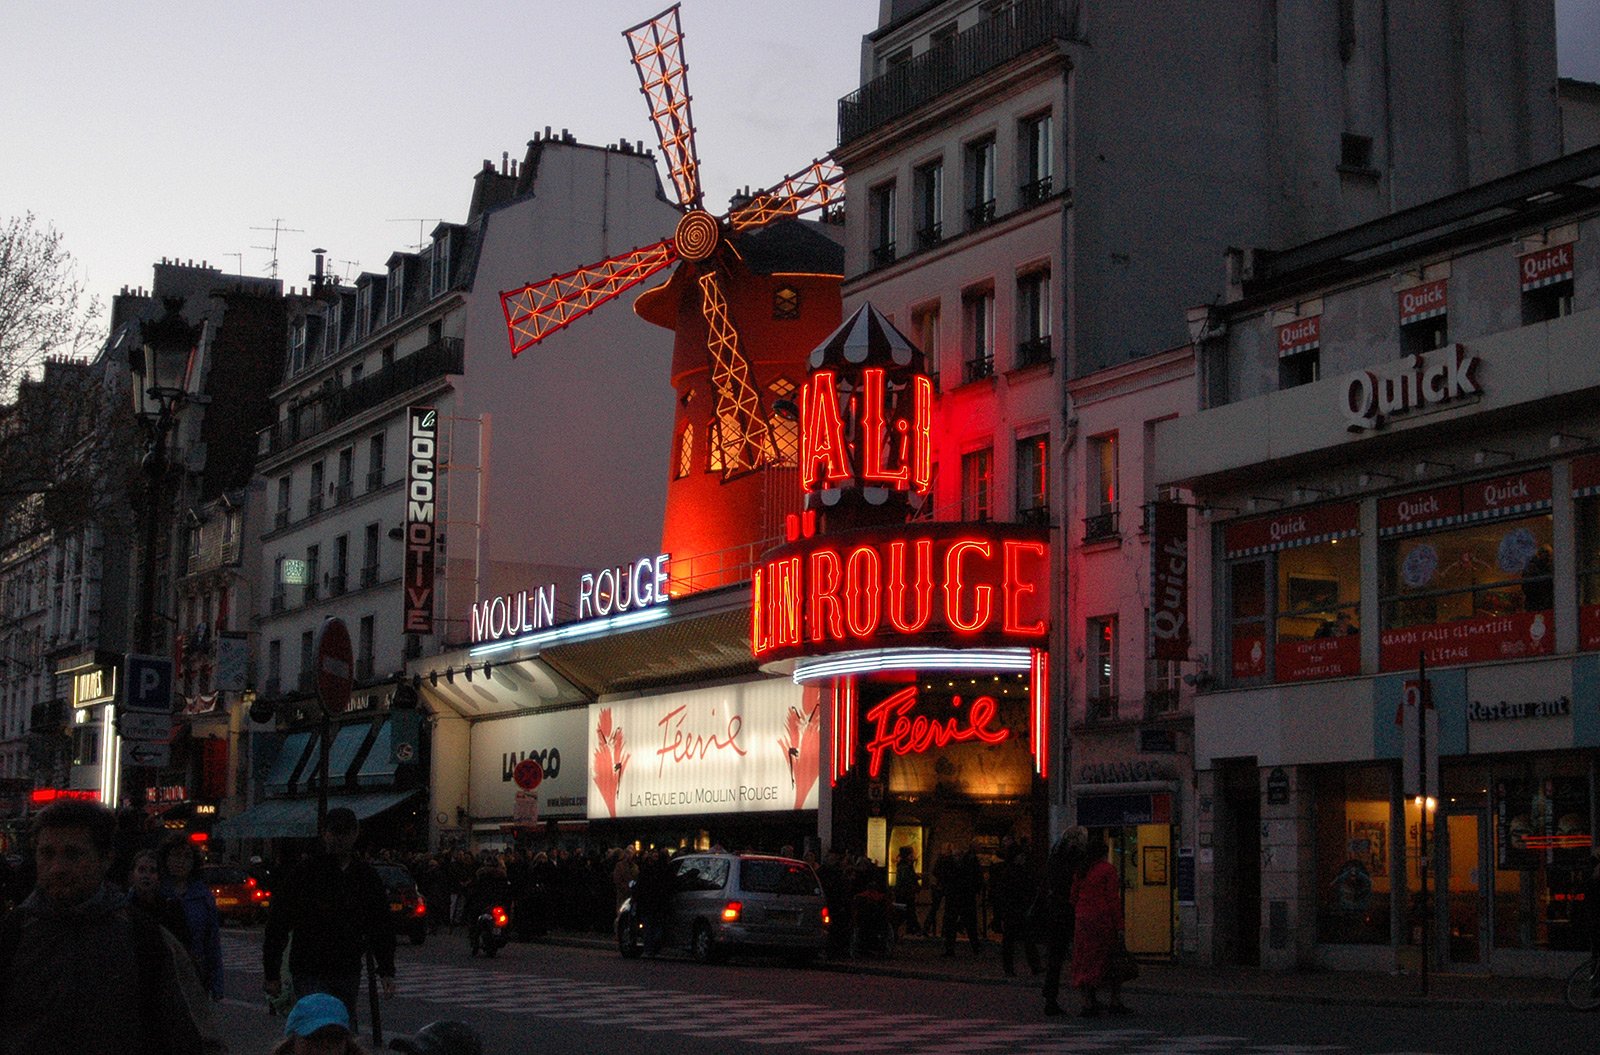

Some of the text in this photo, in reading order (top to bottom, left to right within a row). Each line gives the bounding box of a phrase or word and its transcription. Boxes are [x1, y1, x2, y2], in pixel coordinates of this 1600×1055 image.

[1523, 246, 1569, 279] Quick
[1403, 287, 1444, 313] Quick
[1280, 321, 1317, 347] Quick
[1342, 344, 1480, 431] Quick
[1484, 479, 1528, 504] Quick
[1398, 497, 1439, 521] Quick
[407, 416, 434, 630] LOCOMOTIVE
[1270, 517, 1306, 541] Quick
[472, 553, 671, 643] MOULIN ROUGE
[811, 540, 1046, 642] ROUGE
[1155, 536, 1188, 640] Quick
[1382, 631, 1417, 646] GRANDE
[139, 667, 160, 699] P
[644, 791, 676, 806] REVUE
[695, 788, 736, 804] MOULIN
[739, 786, 778, 801] ROUGE
[197, 805, 215, 814] BAR
